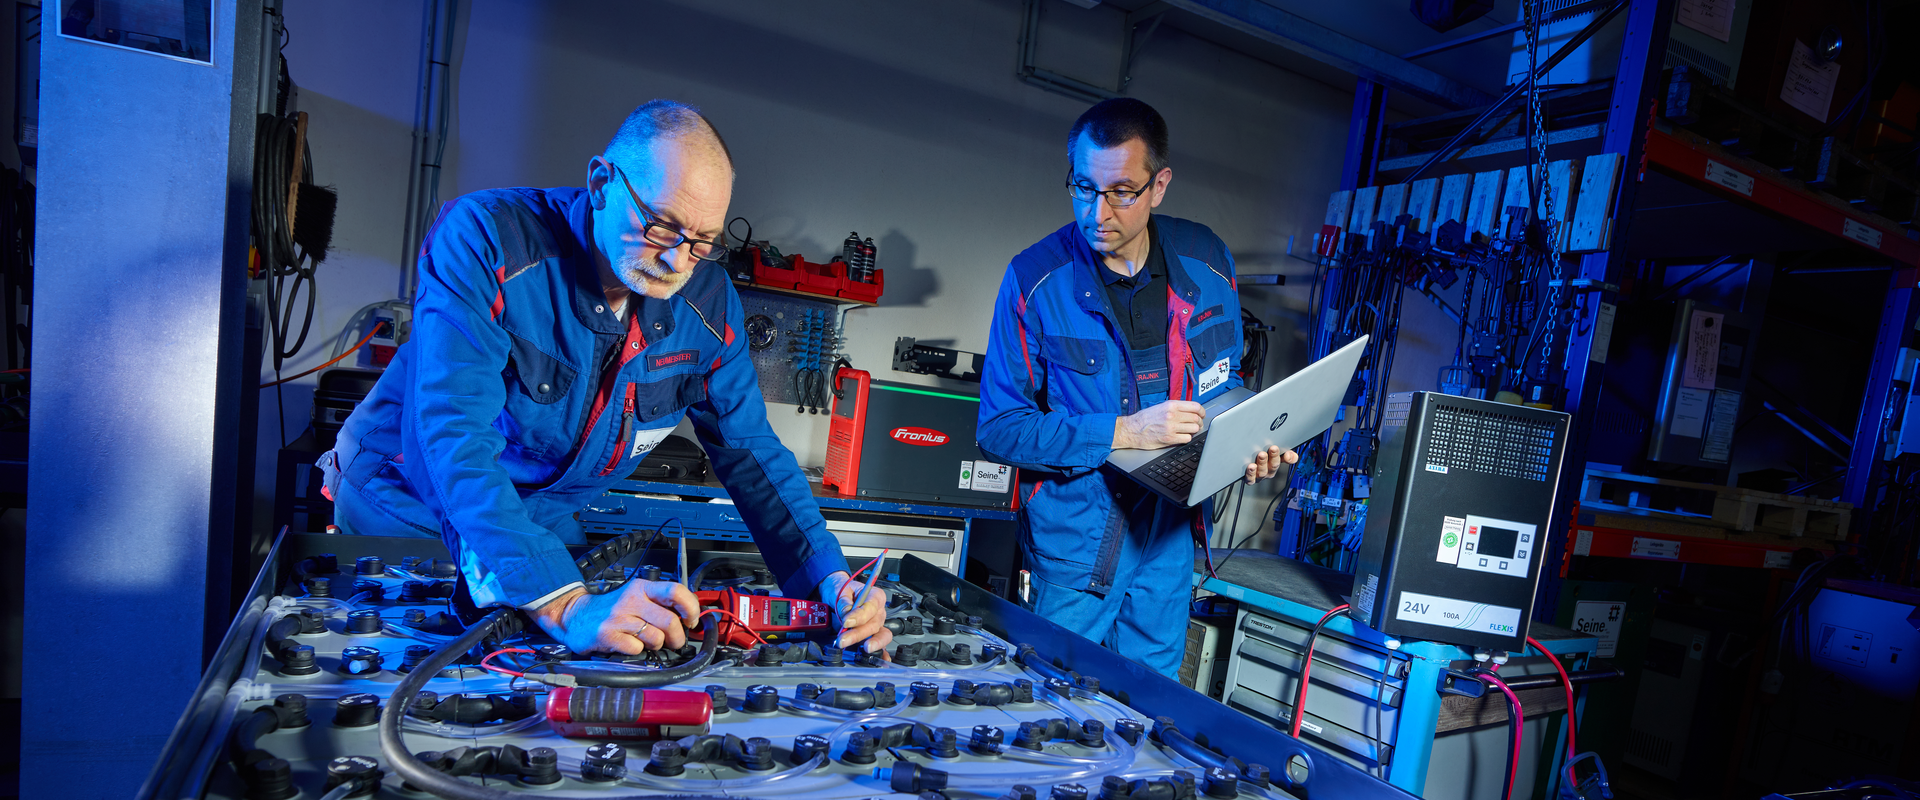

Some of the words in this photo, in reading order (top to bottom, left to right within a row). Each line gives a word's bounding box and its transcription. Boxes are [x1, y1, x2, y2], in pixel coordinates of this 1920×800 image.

[1200, 376, 1221, 393] Seine
[894, 428, 946, 443] Fronius
[977, 470, 999, 480] Seine
[1402, 601, 1430, 615] 24V
[1442, 611, 1461, 620] 100A
[1250, 619, 1275, 631] TRESTON
[1489, 623, 1514, 633] FLEXIS
[1576, 618, 1606, 633] Seine
[1832, 728, 1895, 761] RTM
